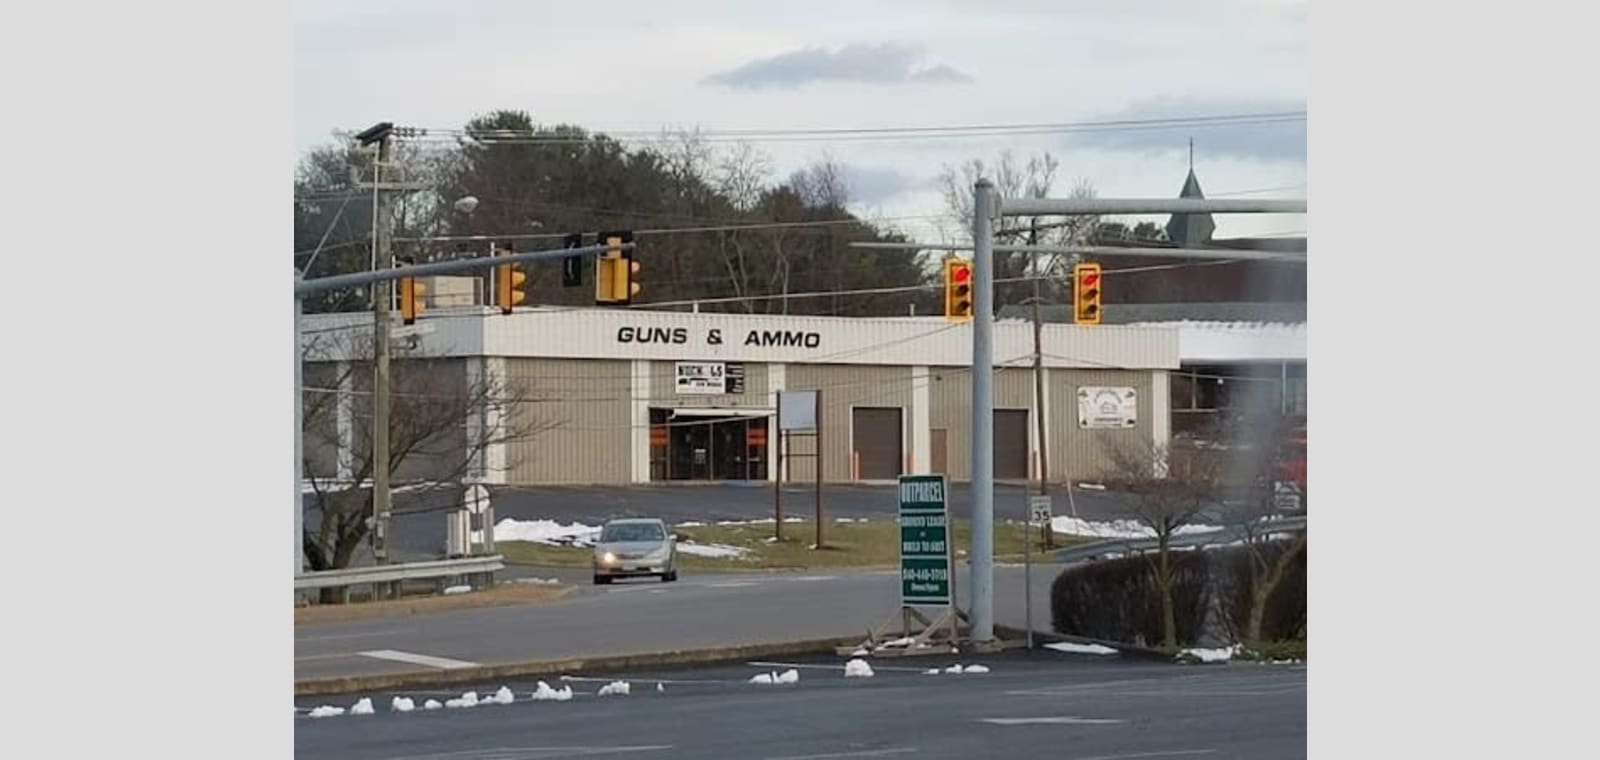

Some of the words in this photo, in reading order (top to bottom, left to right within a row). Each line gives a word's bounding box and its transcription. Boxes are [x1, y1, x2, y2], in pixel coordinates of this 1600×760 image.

[617, 327, 688, 344] GUNS
[706, 329, 723, 345] &
[744, 330, 821, 348] AMMO
[901, 482, 943, 502] OUTPARCEL
[1034, 511, 1050, 521] 35
